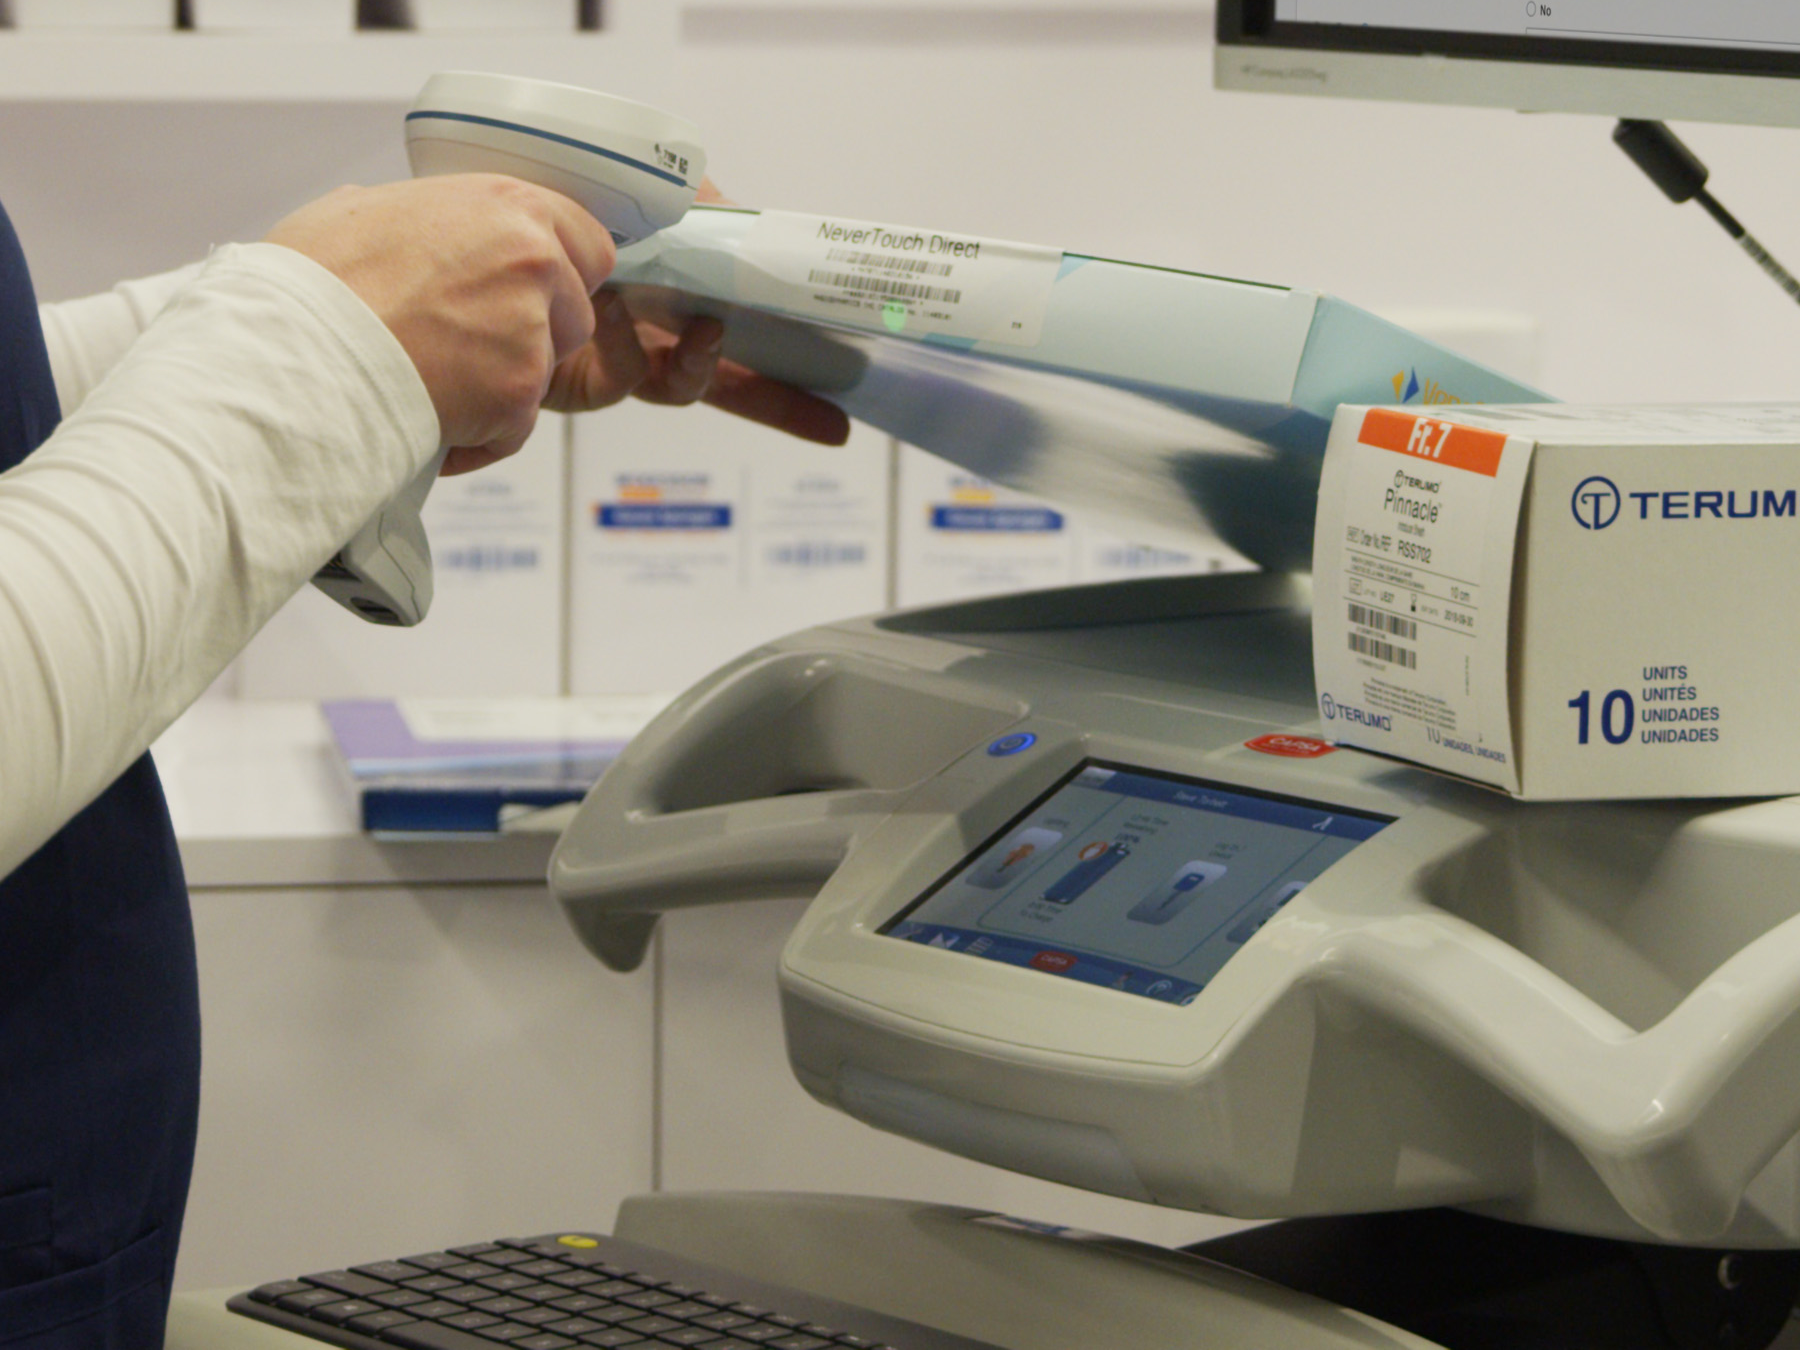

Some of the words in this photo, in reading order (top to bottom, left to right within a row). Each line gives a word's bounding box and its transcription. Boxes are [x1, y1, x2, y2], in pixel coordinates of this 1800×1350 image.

[1540, 4, 1552, 16] No
[816, 221, 924, 251] NeverTouch
[927, 234, 980, 260] Direct
[1406, 417, 1433, 456] Fr.
[1432, 423, 1452, 458] 7
[1404, 476, 1440, 494] TERUMO
[1383, 488, 1439, 524] Pinnacle
[1629, 489, 1797, 520] TERUM
[1643, 666, 1688, 681] UNITS
[1642, 683, 1697, 702] UNITÉS
[1336, 703, 1392, 732] TERUMO
[1568, 689, 1635, 745] 10
[1642, 707, 1719, 723] UNIDADES
[1641, 728, 1719, 744] UNIDADES
